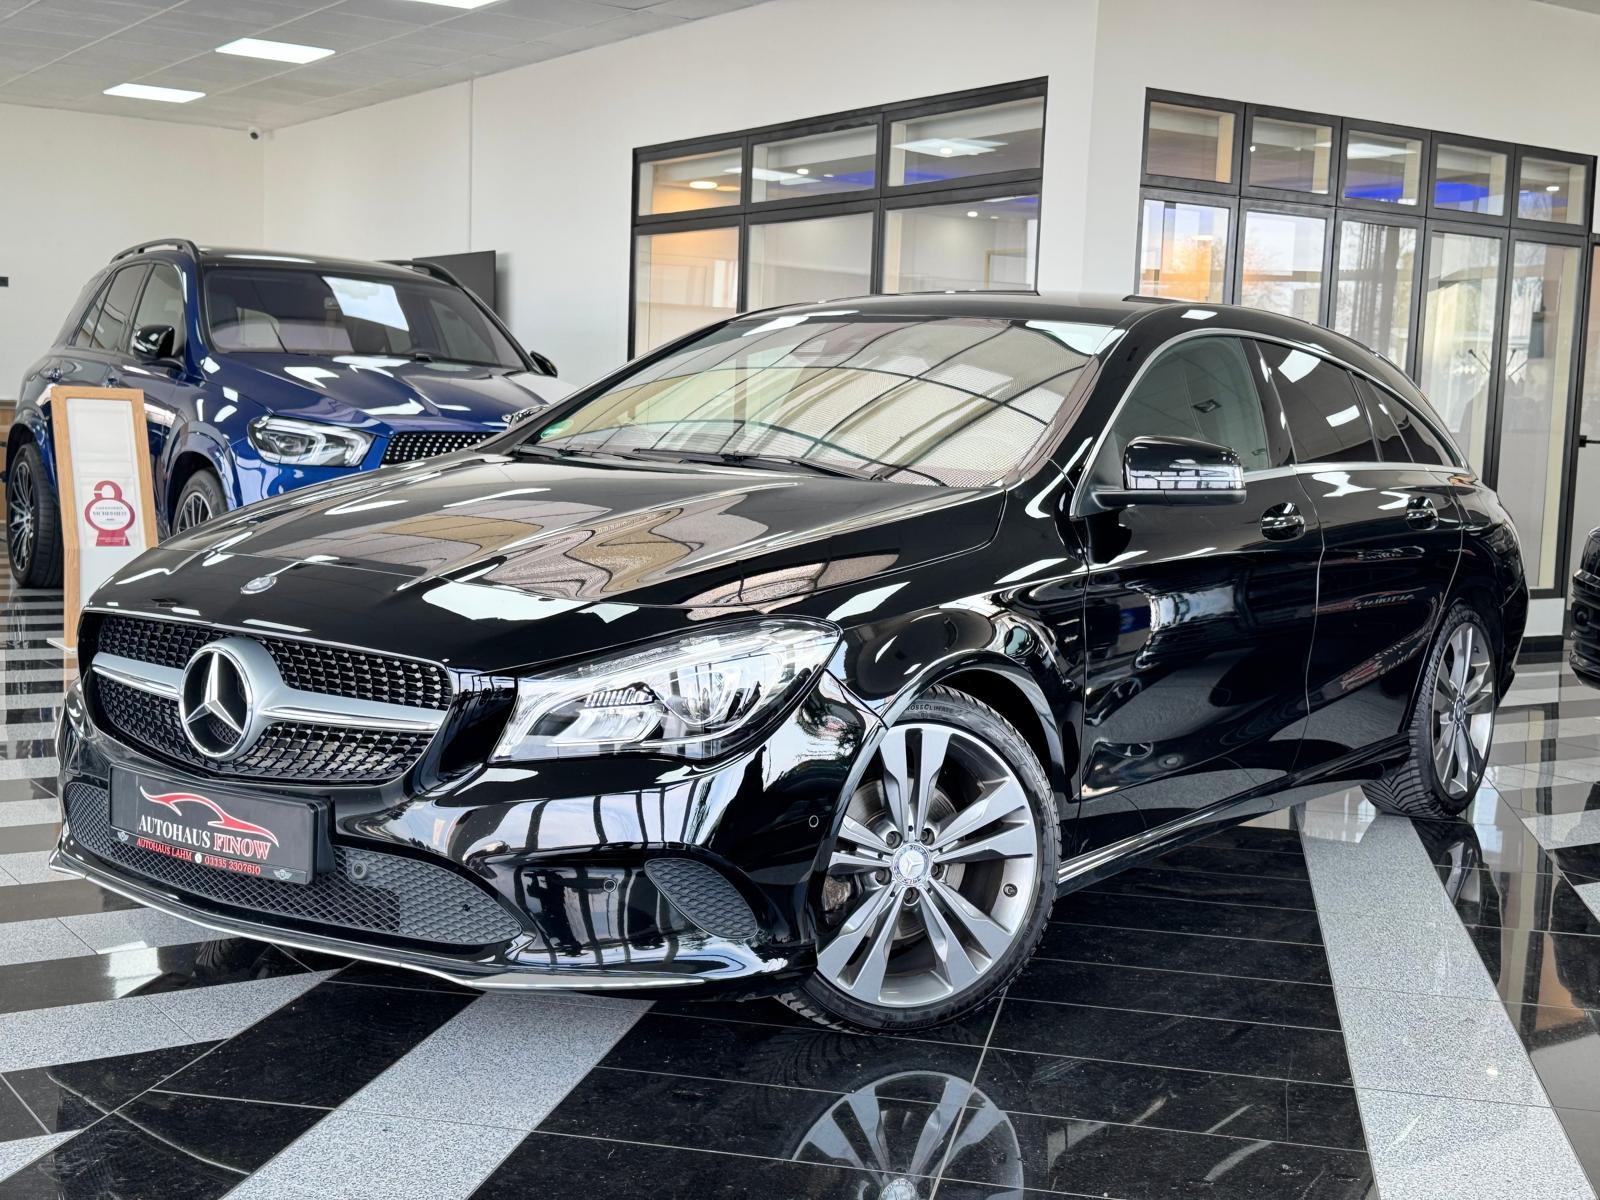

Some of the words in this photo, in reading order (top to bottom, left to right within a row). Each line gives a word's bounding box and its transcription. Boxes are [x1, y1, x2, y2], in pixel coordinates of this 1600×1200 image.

[136, 838, 171, 856] AUTOHAUS
[171, 848, 192, 861] LAHM
[204, 856, 227, 868] 03335
[228, 861, 261, 876] 3307610
[139, 814, 211, 849] AUTOHAUS
[213, 832, 271, 860] FINOW
